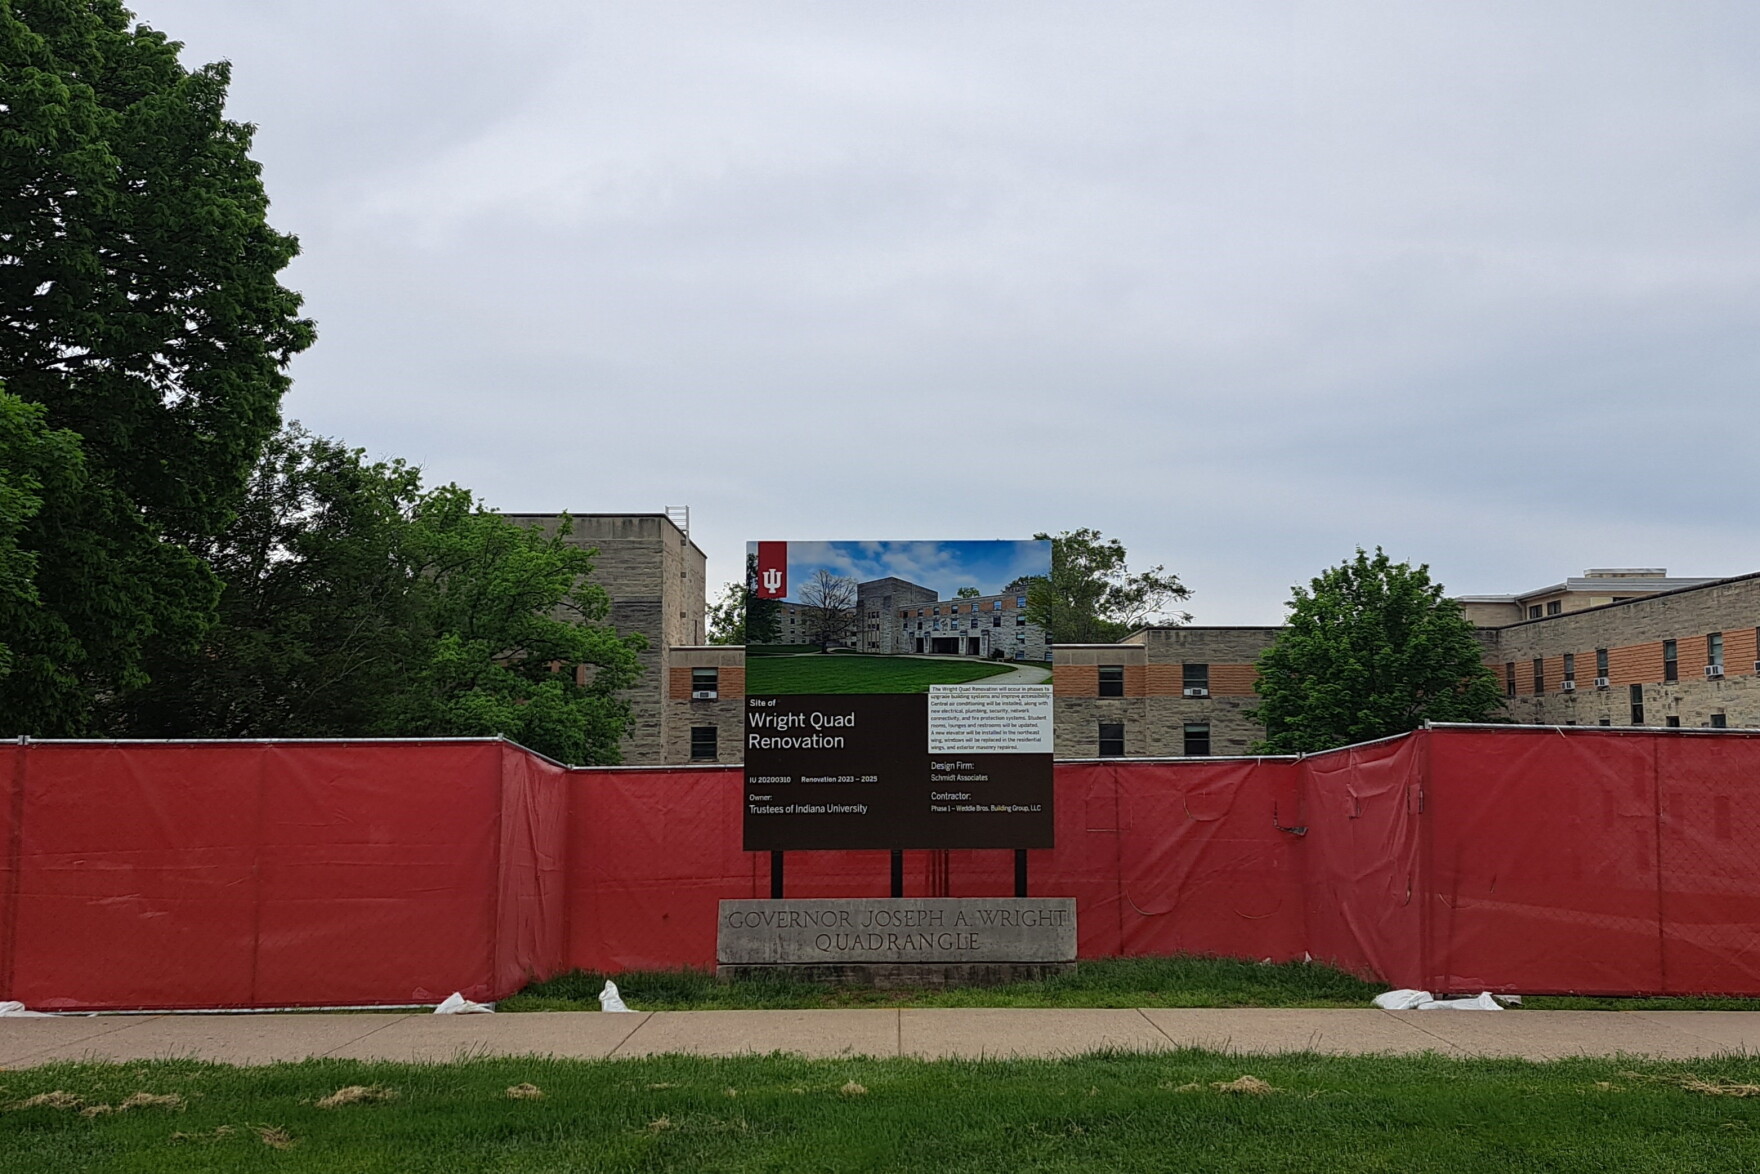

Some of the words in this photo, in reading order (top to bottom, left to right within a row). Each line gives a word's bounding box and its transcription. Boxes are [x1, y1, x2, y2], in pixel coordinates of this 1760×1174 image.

[749, 699, 766, 707] Site
[767, 699, 776, 707] of
[749, 712, 806, 731] Wright
[810, 711, 855, 730] Quad
[749, 733, 844, 749] Renovation
[931, 761, 955, 771] Design
[956, 761, 974, 770] Firm:
[931, 792, 971, 800] Contractor:
[749, 805, 784, 814] Trustees
[785, 805, 794, 813] of
[795, 805, 825, 813] Indiana
[827, 804, 868, 814] University
[727, 910, 853, 929] GOVERNOR
[862, 910, 944, 928] JOSEPH
[954, 910, 973, 928] A.
[977, 909, 1067, 928] WRIGHT
[815, 932, 980, 953] QUADRANGLE
